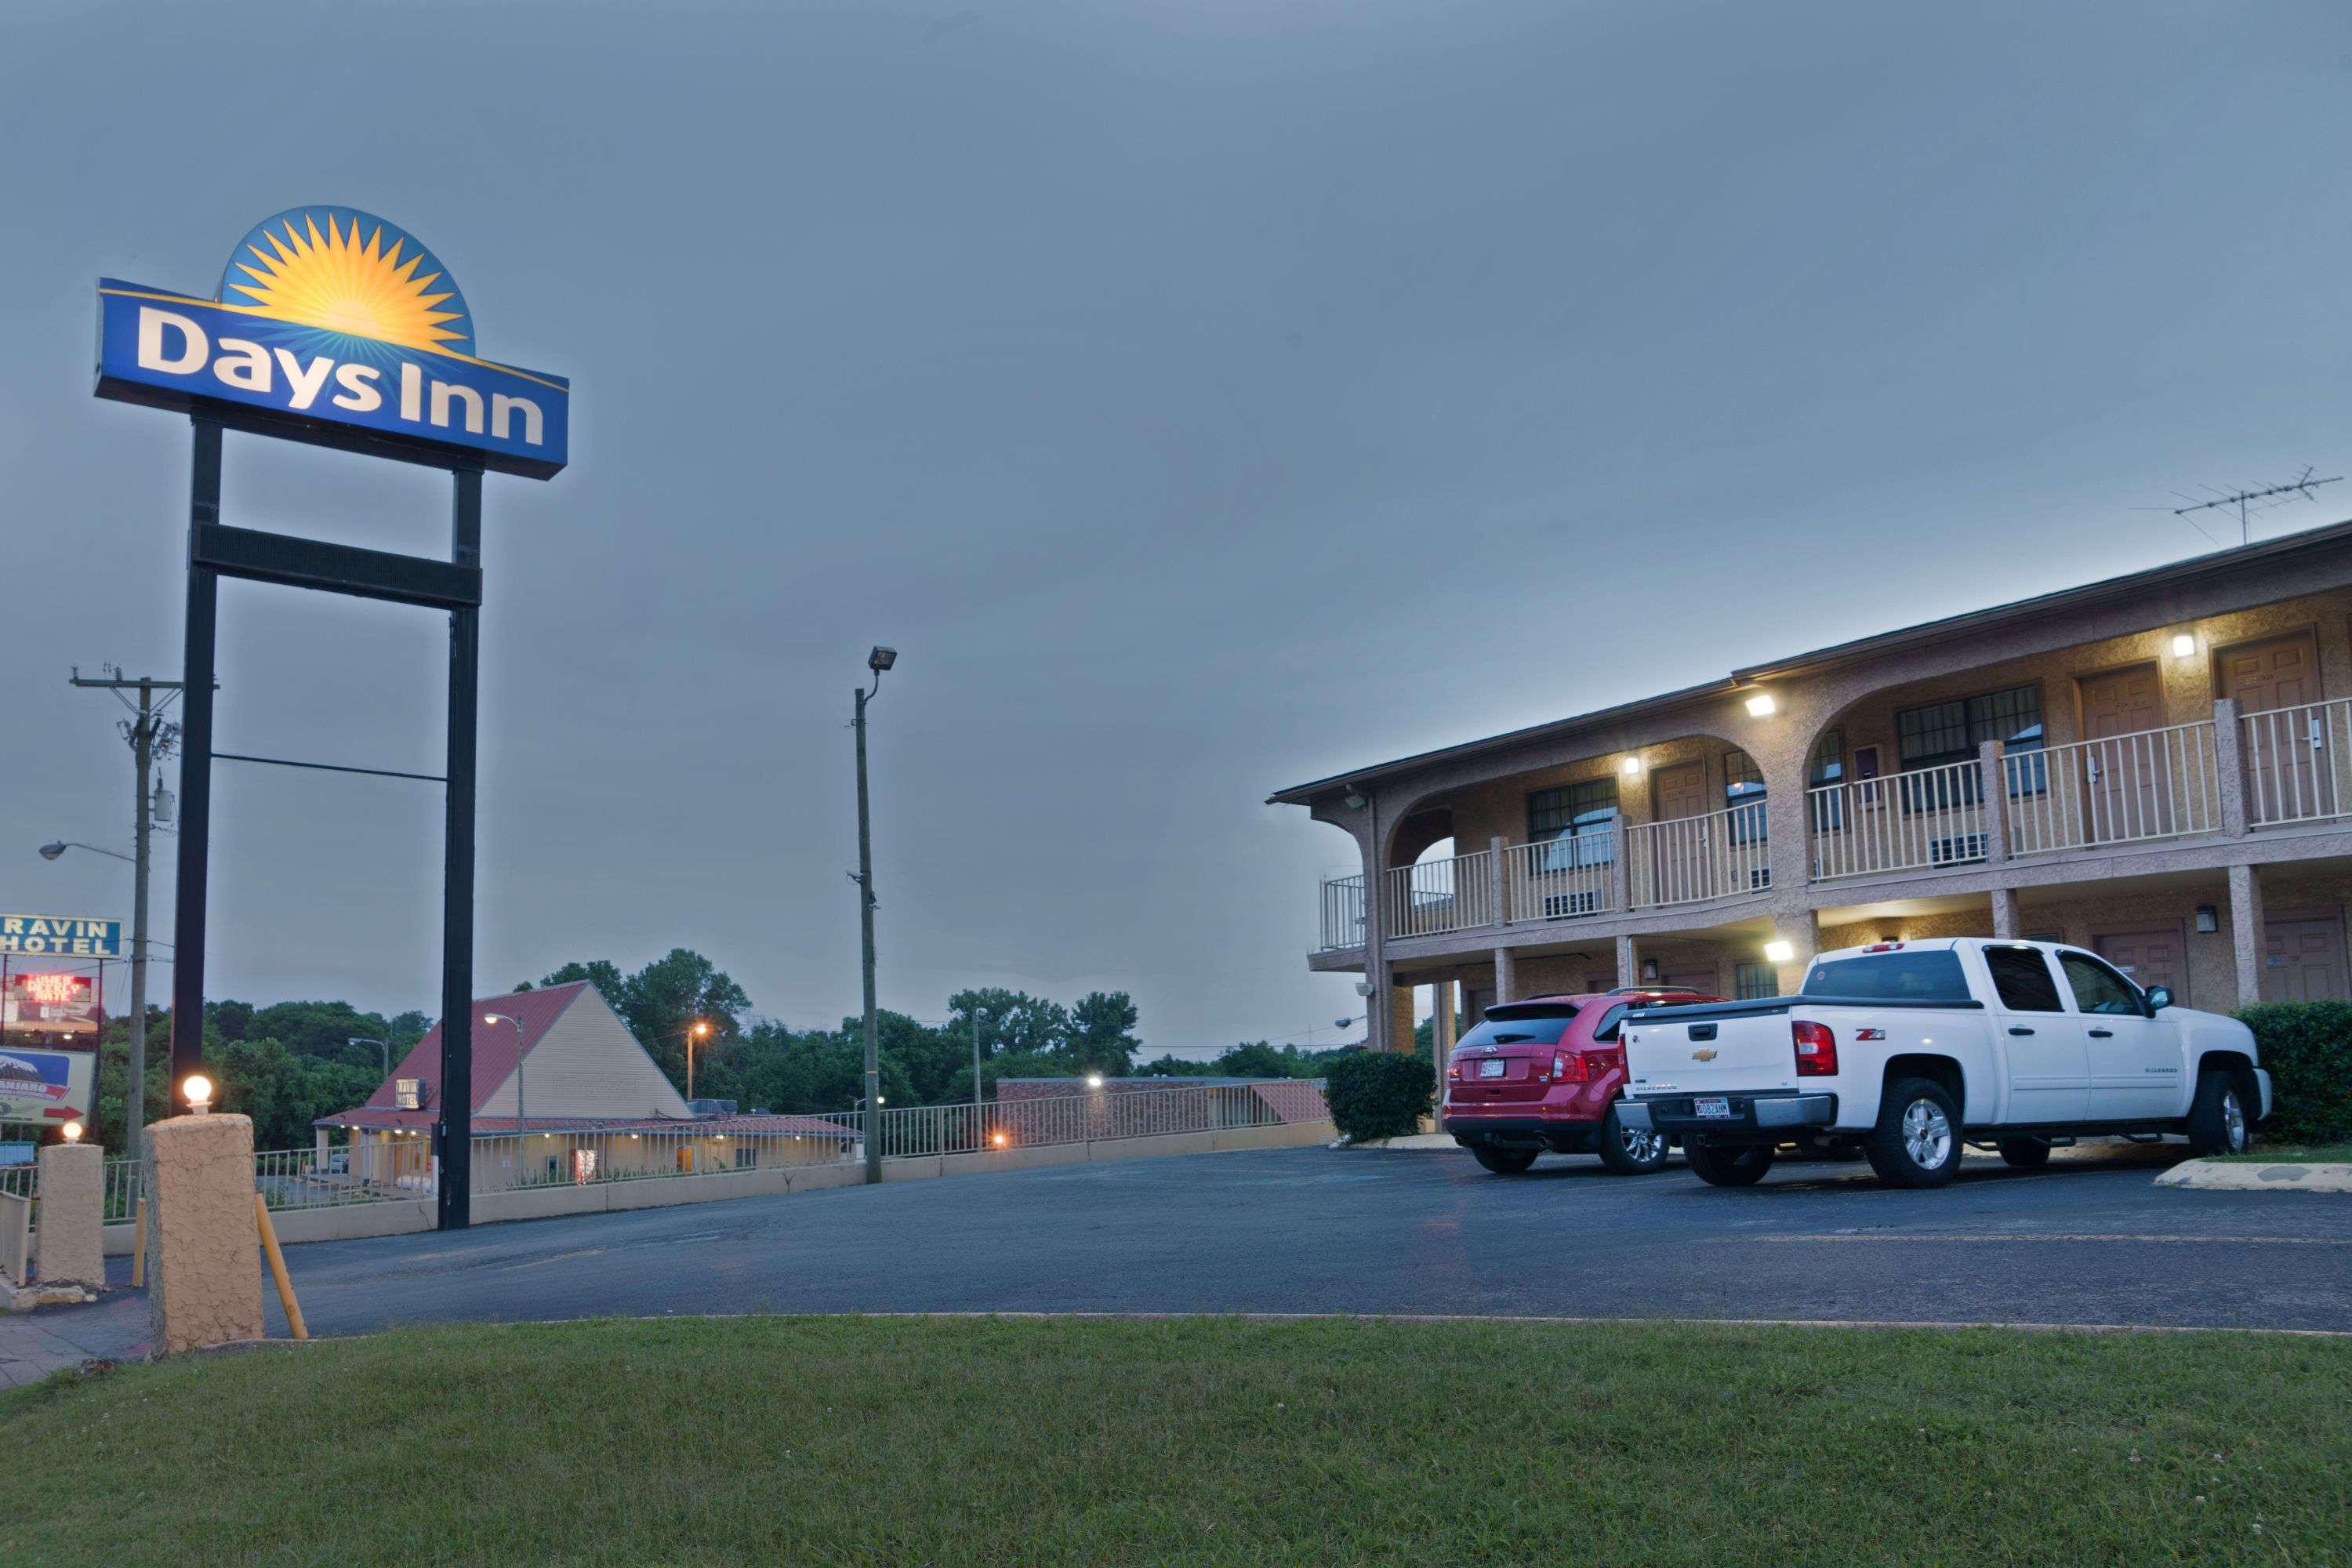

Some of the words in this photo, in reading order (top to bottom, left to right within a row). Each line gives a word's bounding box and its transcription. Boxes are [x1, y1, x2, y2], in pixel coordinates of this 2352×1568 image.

[138, 306, 382, 412] Days
[401, 362, 543, 446] Inn
[4, 917, 107, 938] RAVIN
[0, 935, 111, 954] HOTEL
